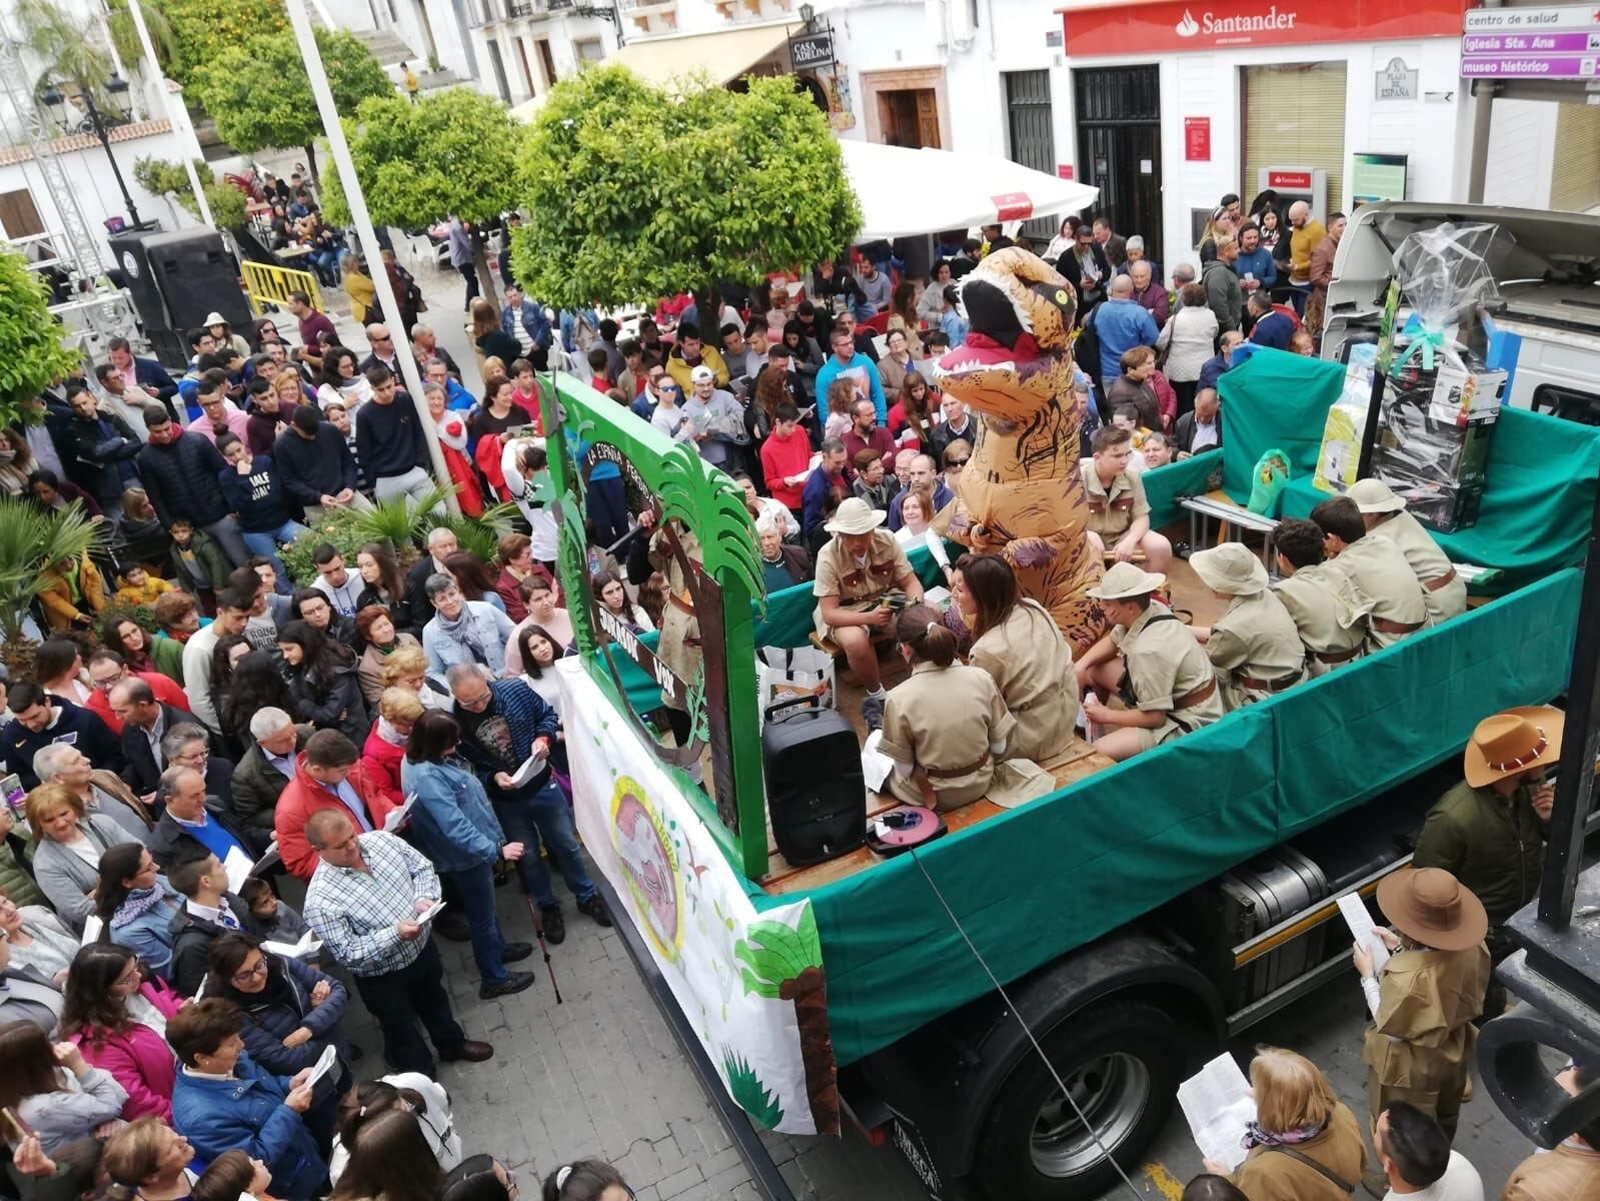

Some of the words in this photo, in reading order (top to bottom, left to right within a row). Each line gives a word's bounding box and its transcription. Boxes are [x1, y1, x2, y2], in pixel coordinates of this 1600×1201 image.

[1202, 5, 1297, 34] Santander
[1468, 15, 1503, 25] centro
[1508, 15, 1521, 24] de
[1526, 13, 1559, 23] salud
[794, 41, 817, 54] CASA
[1504, 37, 1528, 49] Sta.
[1531, 36, 1555, 49] Ana
[796, 47, 832, 62] ADELINA
[1463, 63, 1498, 73] museo
[1500, 60, 1549, 73] histórico
[1387, 72, 1407, 80] PLAZA
[1381, 86, 1409, 97] ESPAÑA
[596, 442, 623, 465] ESPAÑA
